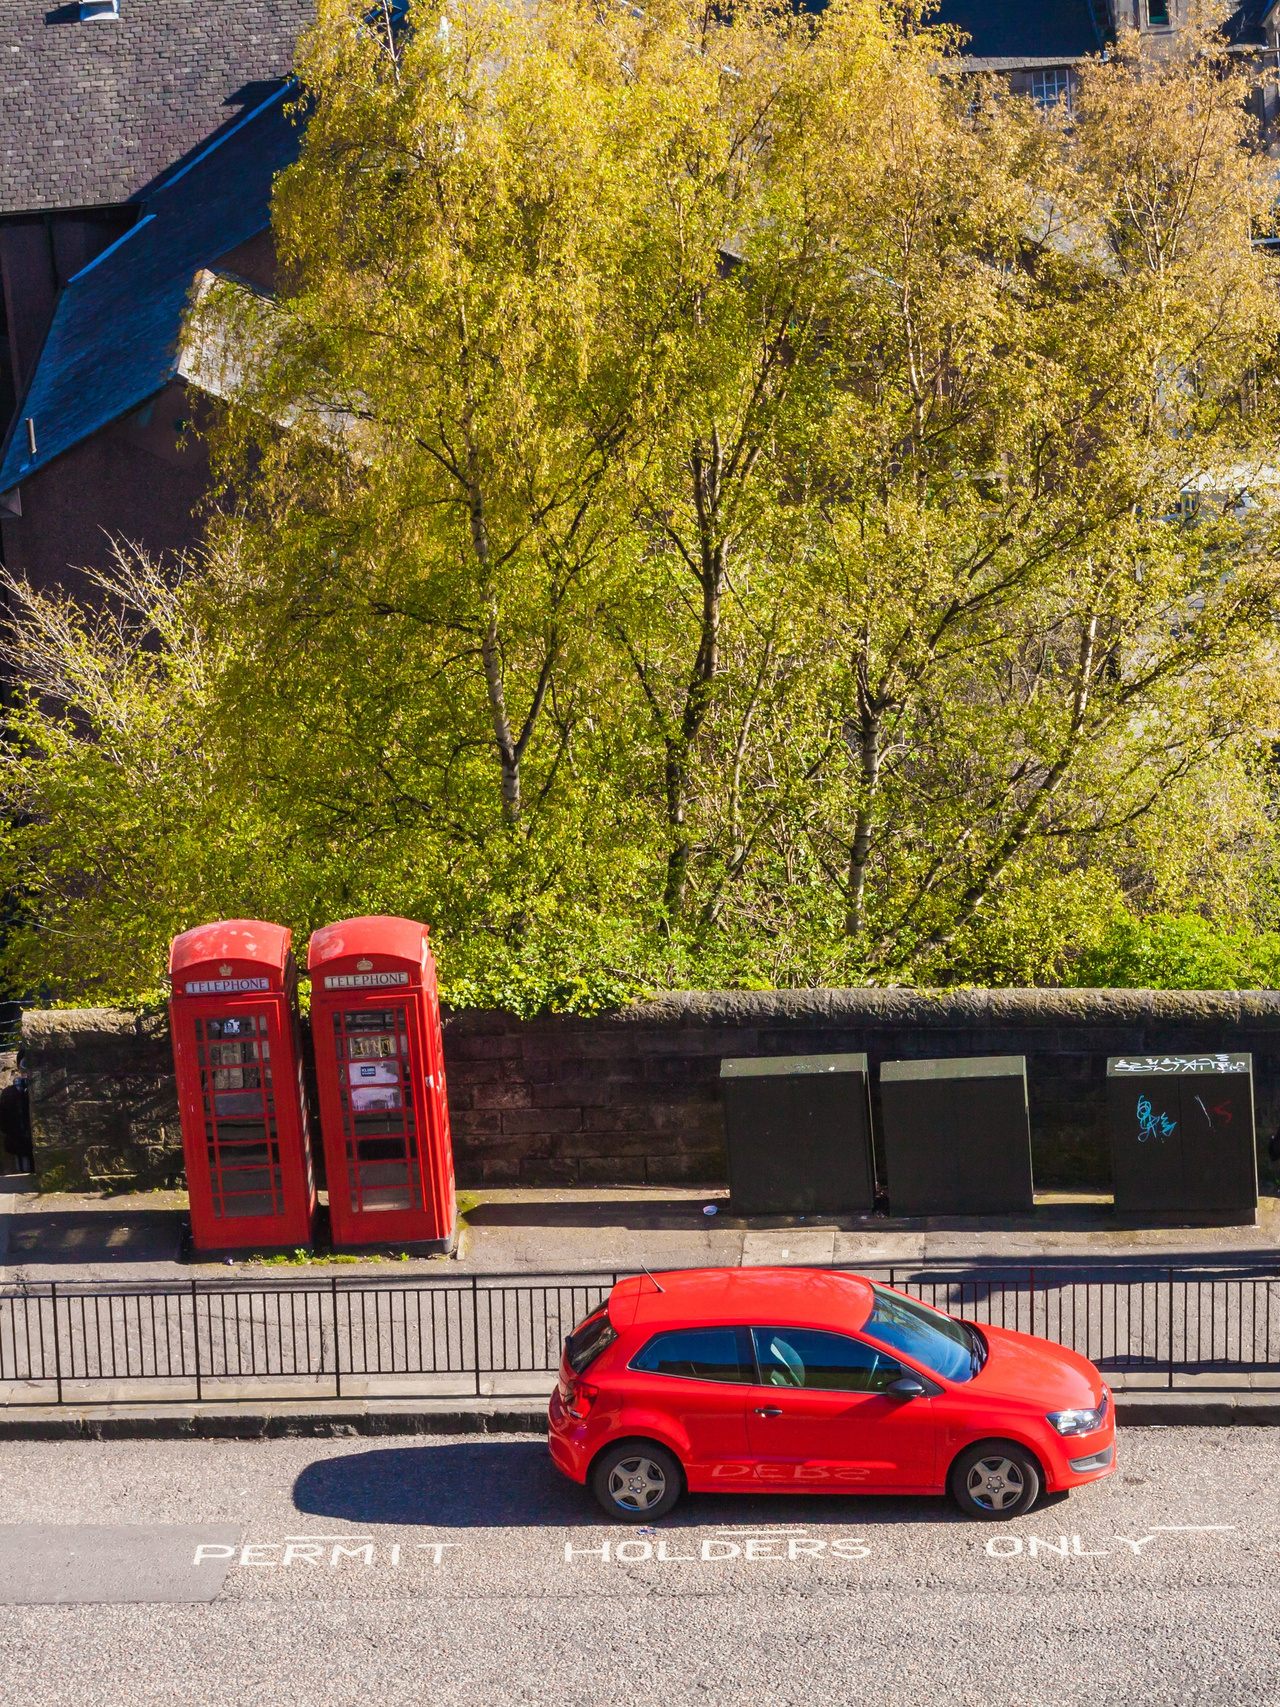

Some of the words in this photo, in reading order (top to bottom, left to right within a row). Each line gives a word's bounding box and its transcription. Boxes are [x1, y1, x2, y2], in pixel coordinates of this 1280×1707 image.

[190, 979, 267, 992] TELEPHONE
[329, 973, 406, 986] TELEPHONE
[193, 1544, 461, 1565] PERMIT
[564, 1538, 871, 1562] HOLDERS
[986, 1535, 1156, 1557] ONLY
